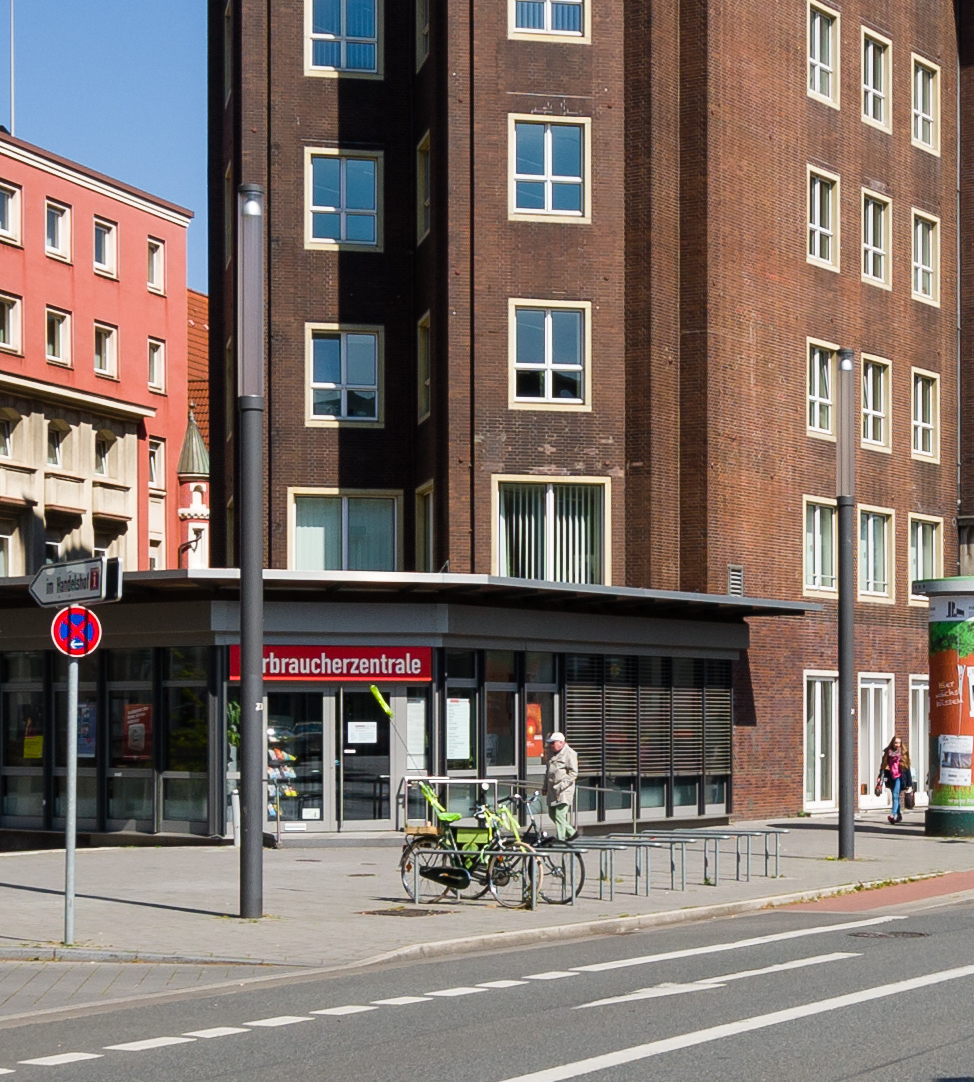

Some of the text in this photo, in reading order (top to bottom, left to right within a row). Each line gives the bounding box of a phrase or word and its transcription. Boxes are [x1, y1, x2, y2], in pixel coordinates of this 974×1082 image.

[46, 572, 89, 595] im Handelshof
[262, 652, 421, 674] rbraucherzentrale
